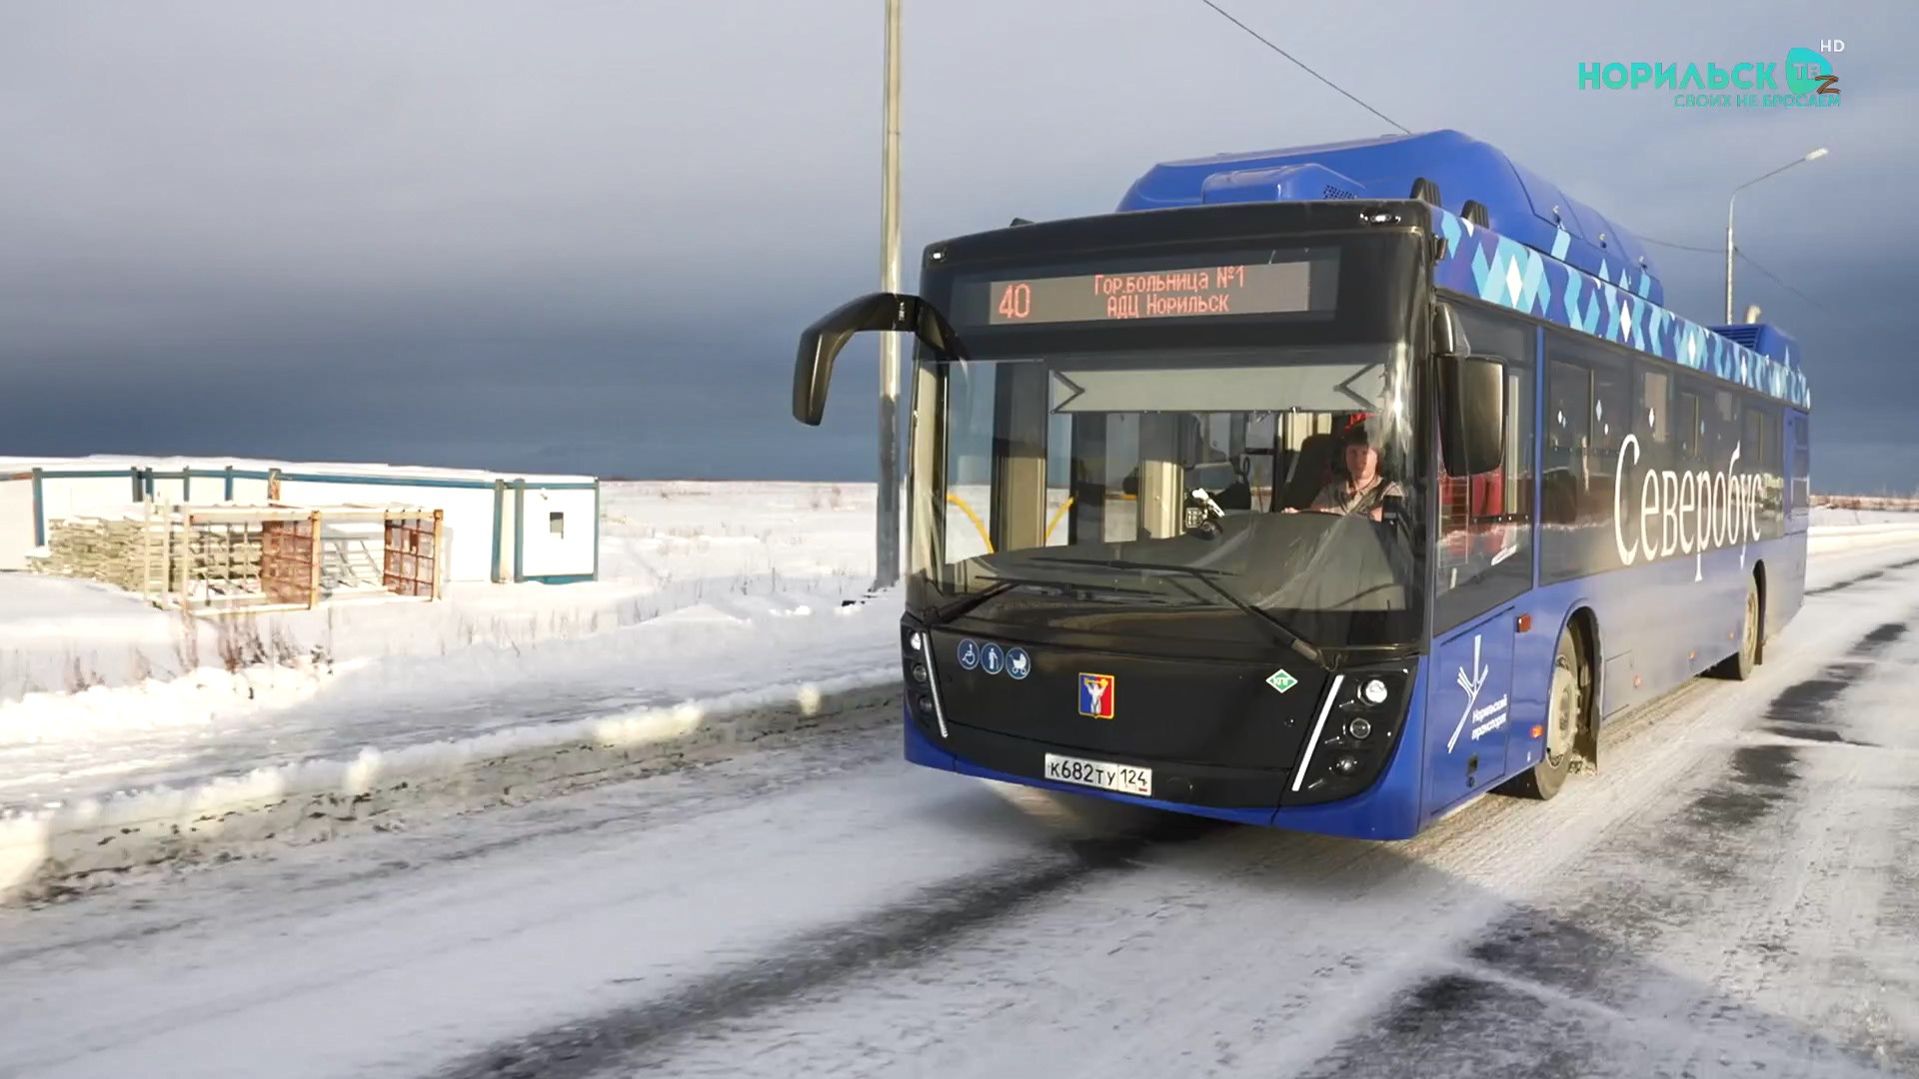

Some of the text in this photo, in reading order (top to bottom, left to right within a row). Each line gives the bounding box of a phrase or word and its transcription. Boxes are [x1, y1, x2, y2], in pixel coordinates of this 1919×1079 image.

[1216, 265, 1245, 289] №1
[998, 283, 1031, 319] 40
[1107, 294, 1139, 319] АДЦ
[1614, 434, 1761, 583] Северобус
